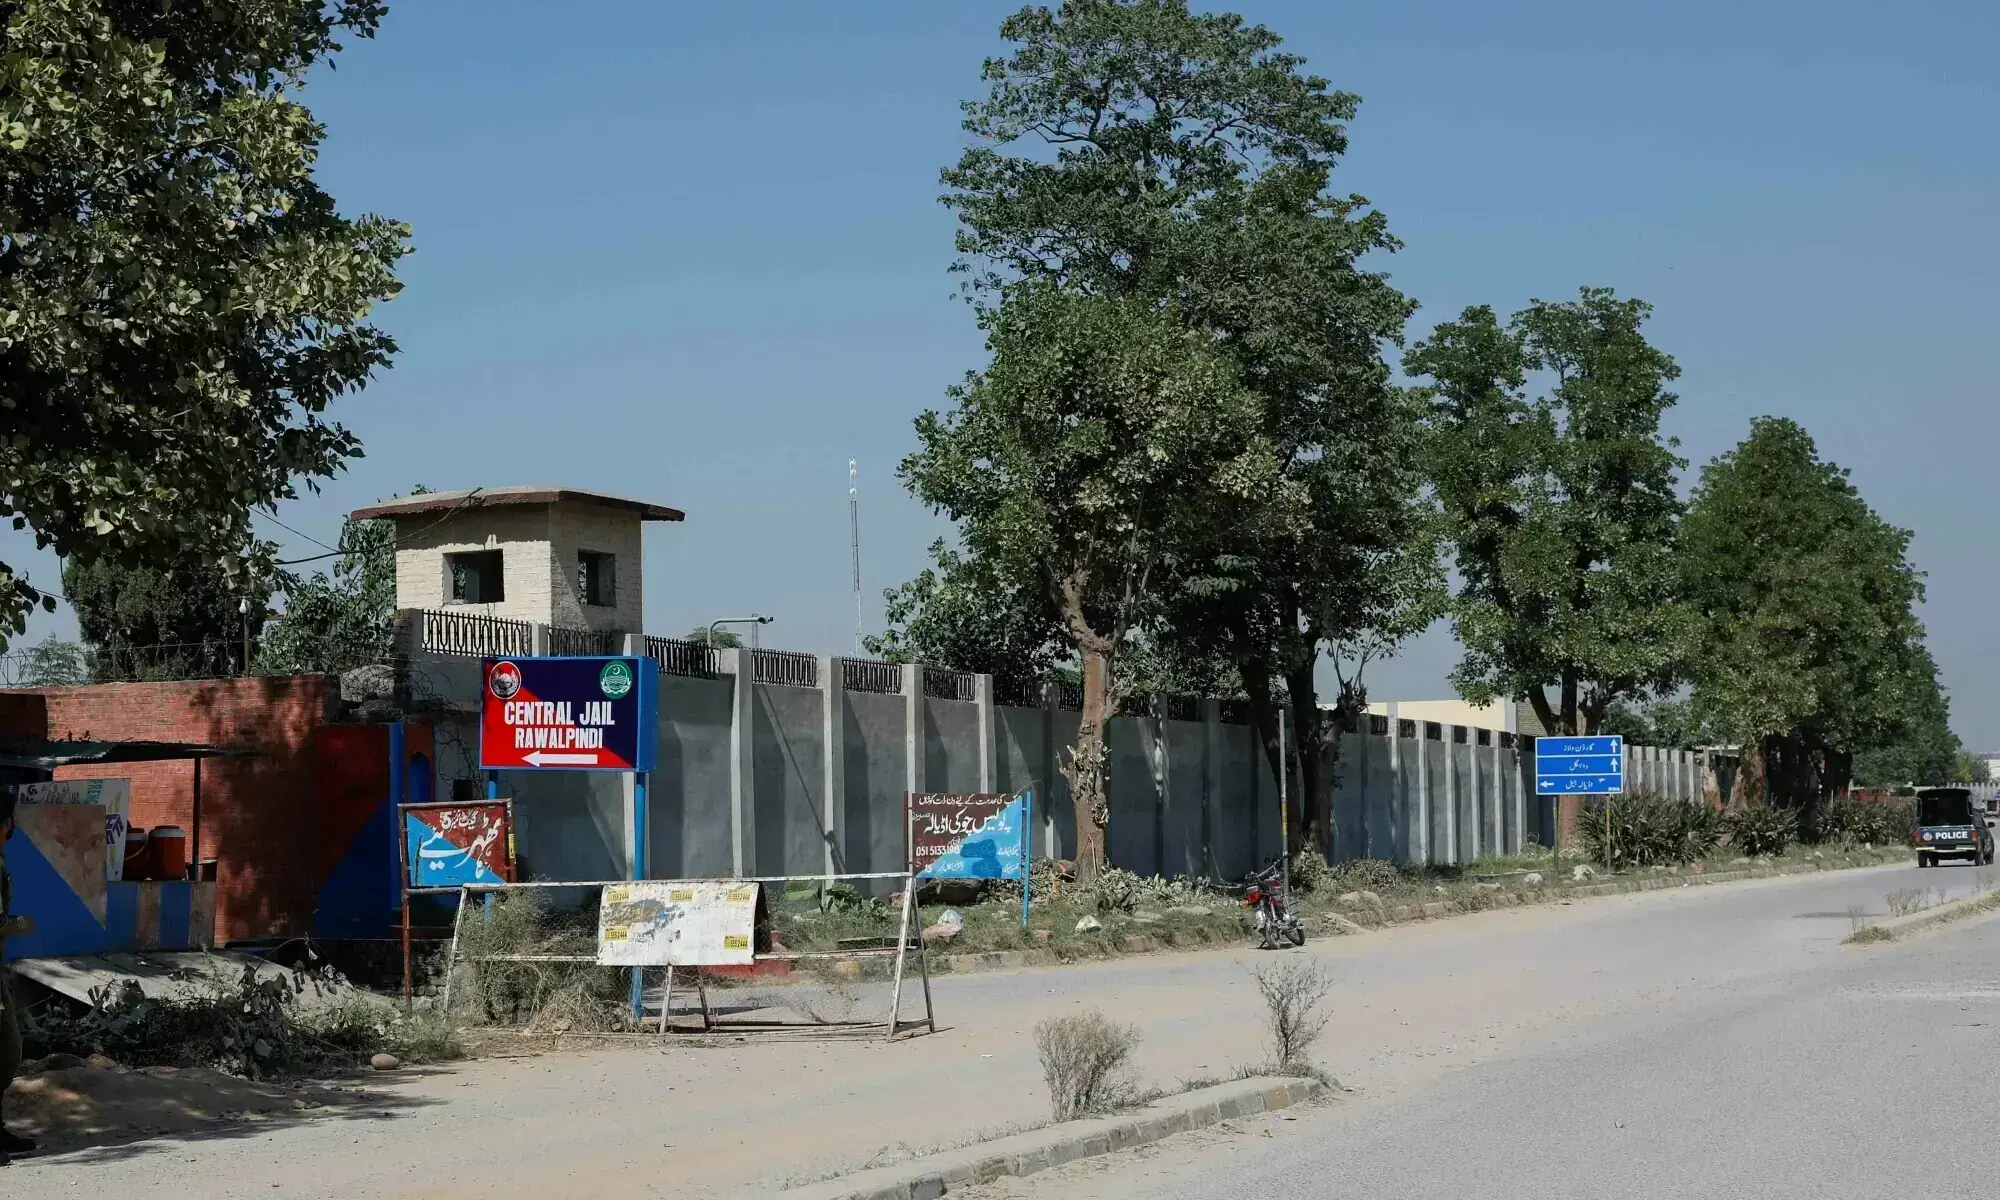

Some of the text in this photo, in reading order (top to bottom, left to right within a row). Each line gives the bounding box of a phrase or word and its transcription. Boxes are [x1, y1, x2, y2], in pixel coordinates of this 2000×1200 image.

[504, 701, 615, 725] CENTRAL JAIL
[515, 728, 603, 749] RAWALPINDI
[1565, 779, 1593, 790] اڈیالہ جیل
[933, 795, 947, 804] رات
[946, 796, 955, 805] دن
[965, 793, 975, 805] کے
[997, 793, 1006, 805] کی
[440, 811, 452, 830] 5
[924, 806, 1012, 836] پولیس چوکی اڈیالہ
[1935, 831, 1968, 840] POLICE
[916, 846, 928, 857] 051
